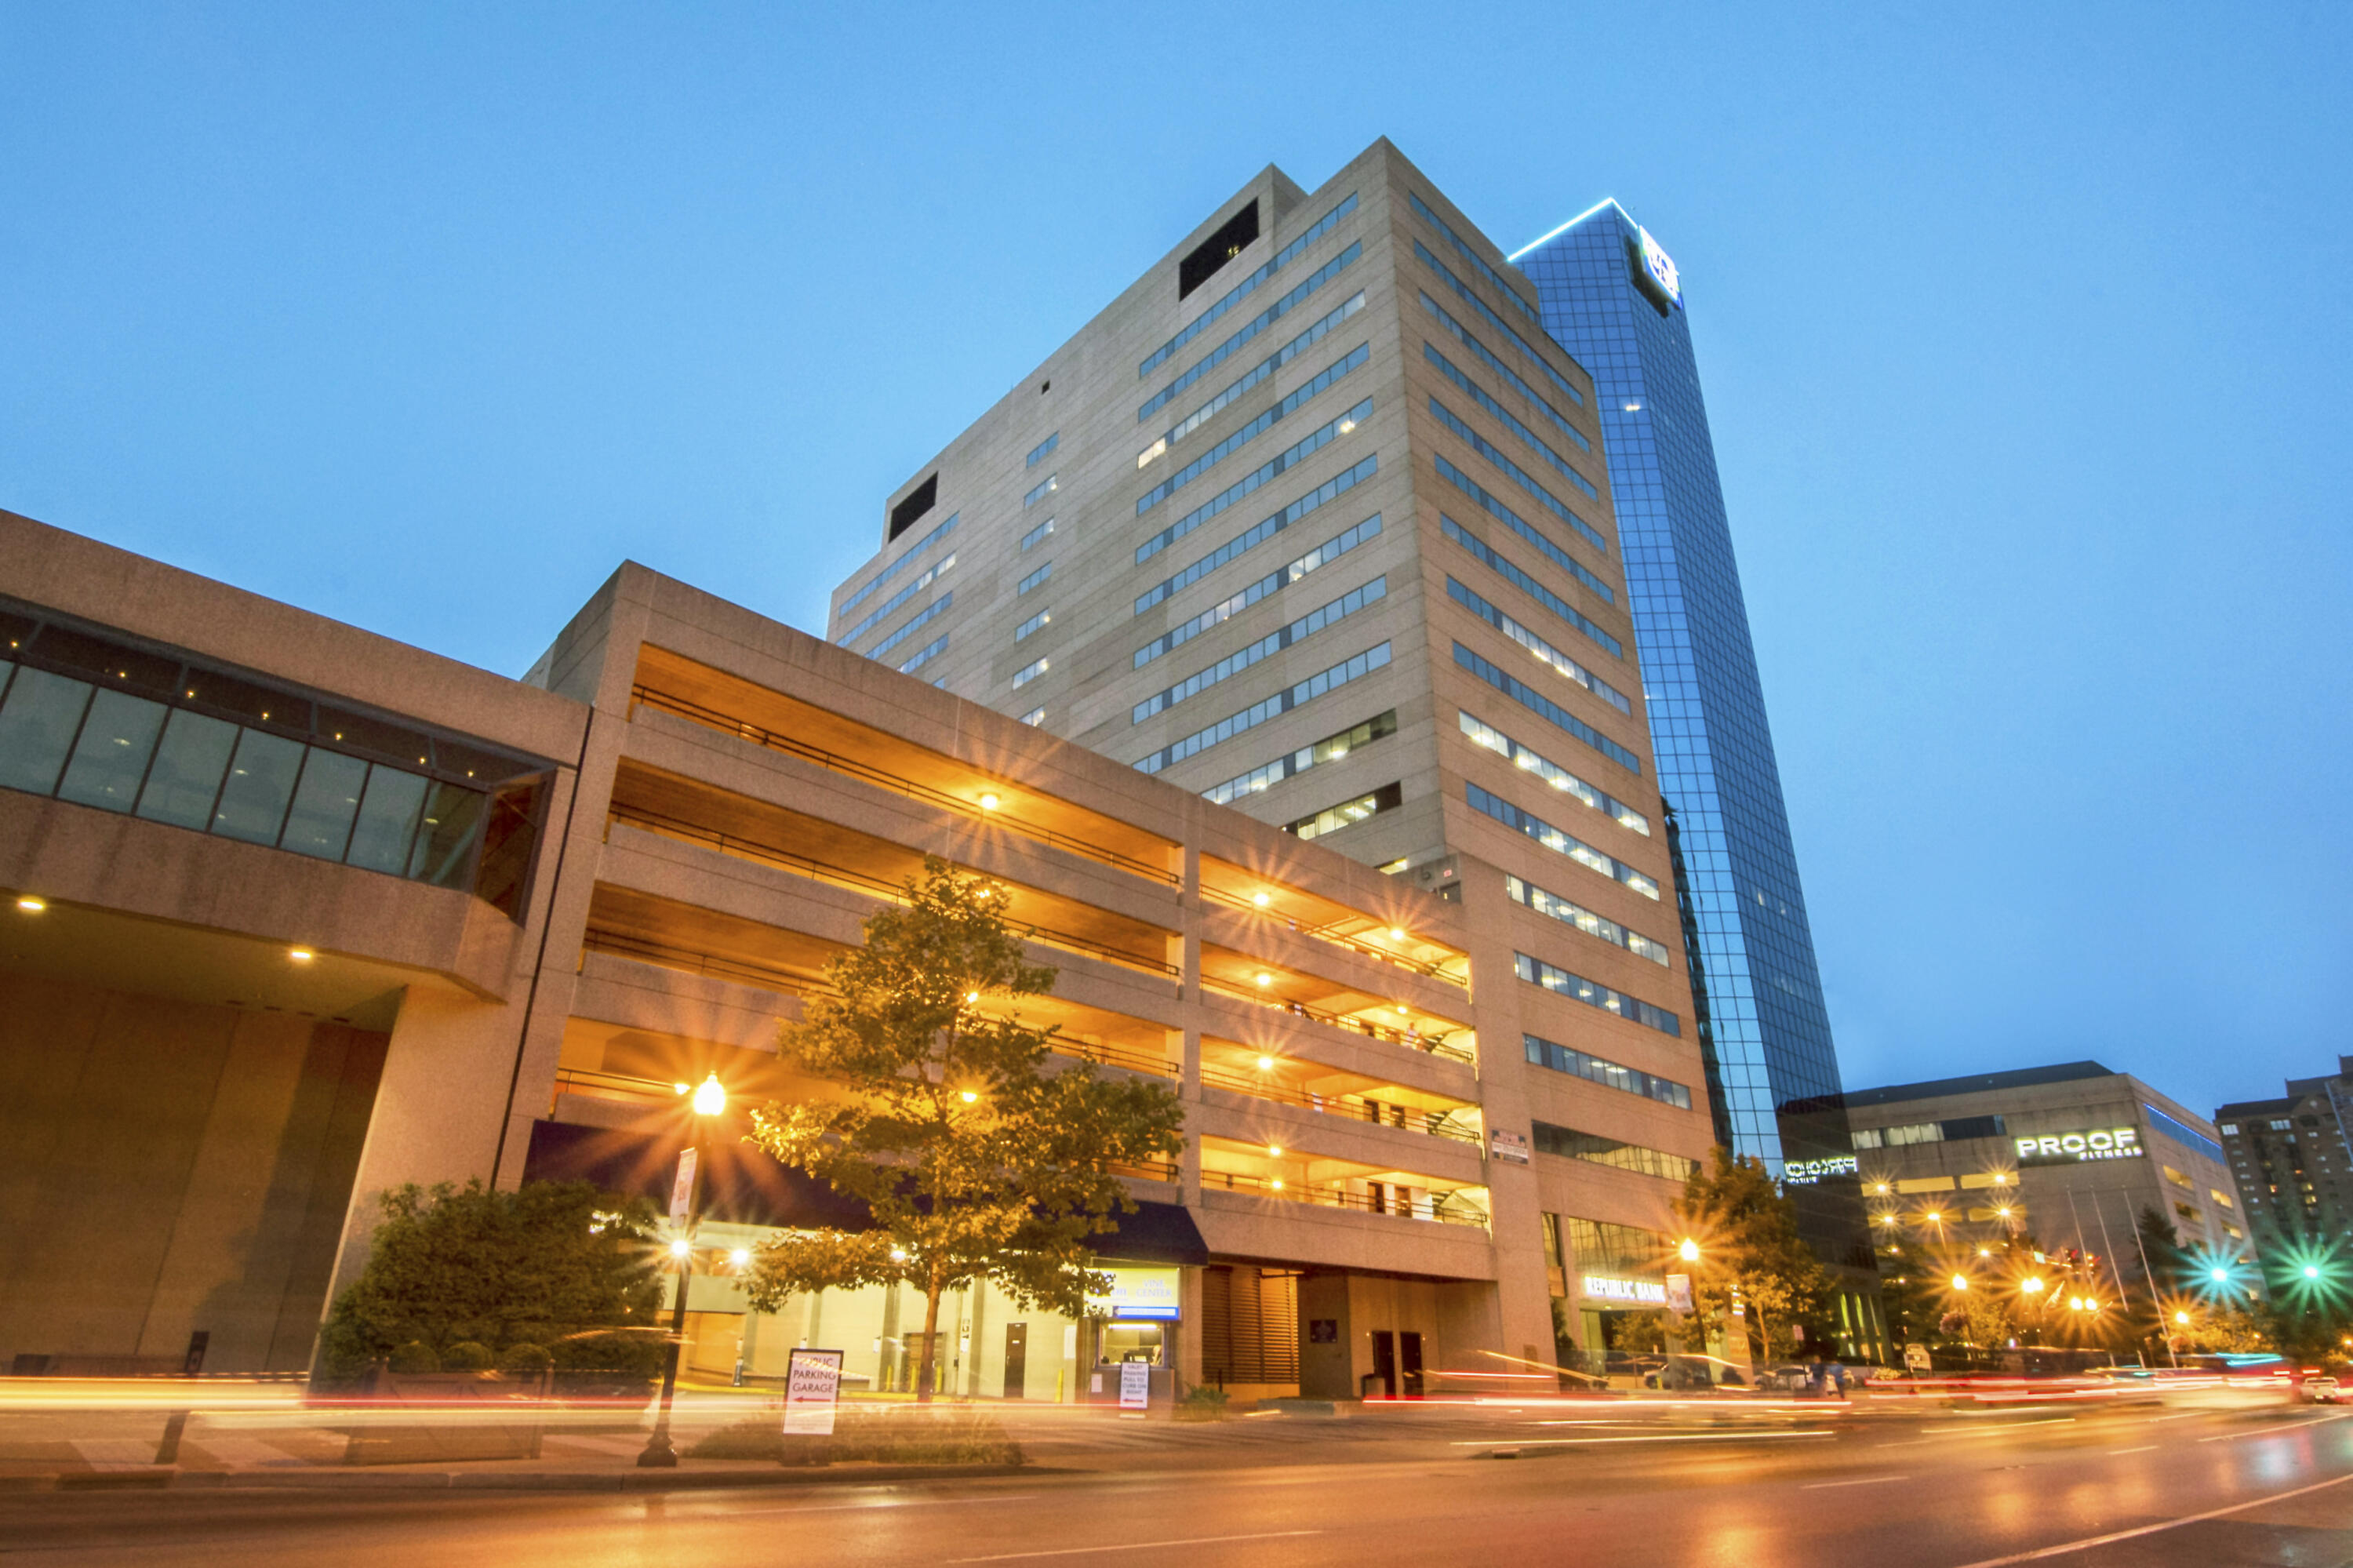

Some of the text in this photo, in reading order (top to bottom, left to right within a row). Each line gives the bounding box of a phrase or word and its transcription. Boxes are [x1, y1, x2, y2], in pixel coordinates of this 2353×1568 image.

[2015, 1126, 2135, 1158] PROOF
[2078, 1146, 2143, 1161] FITNESS
[1136, 1288, 1173, 1297] CENTER
[1584, 1276, 1666, 1303] REPUBLIC BANK
[798, 1356, 834, 1367] BLIC
[793, 1370, 836, 1380] PARKING
[792, 1383, 834, 1392] GARAGE
